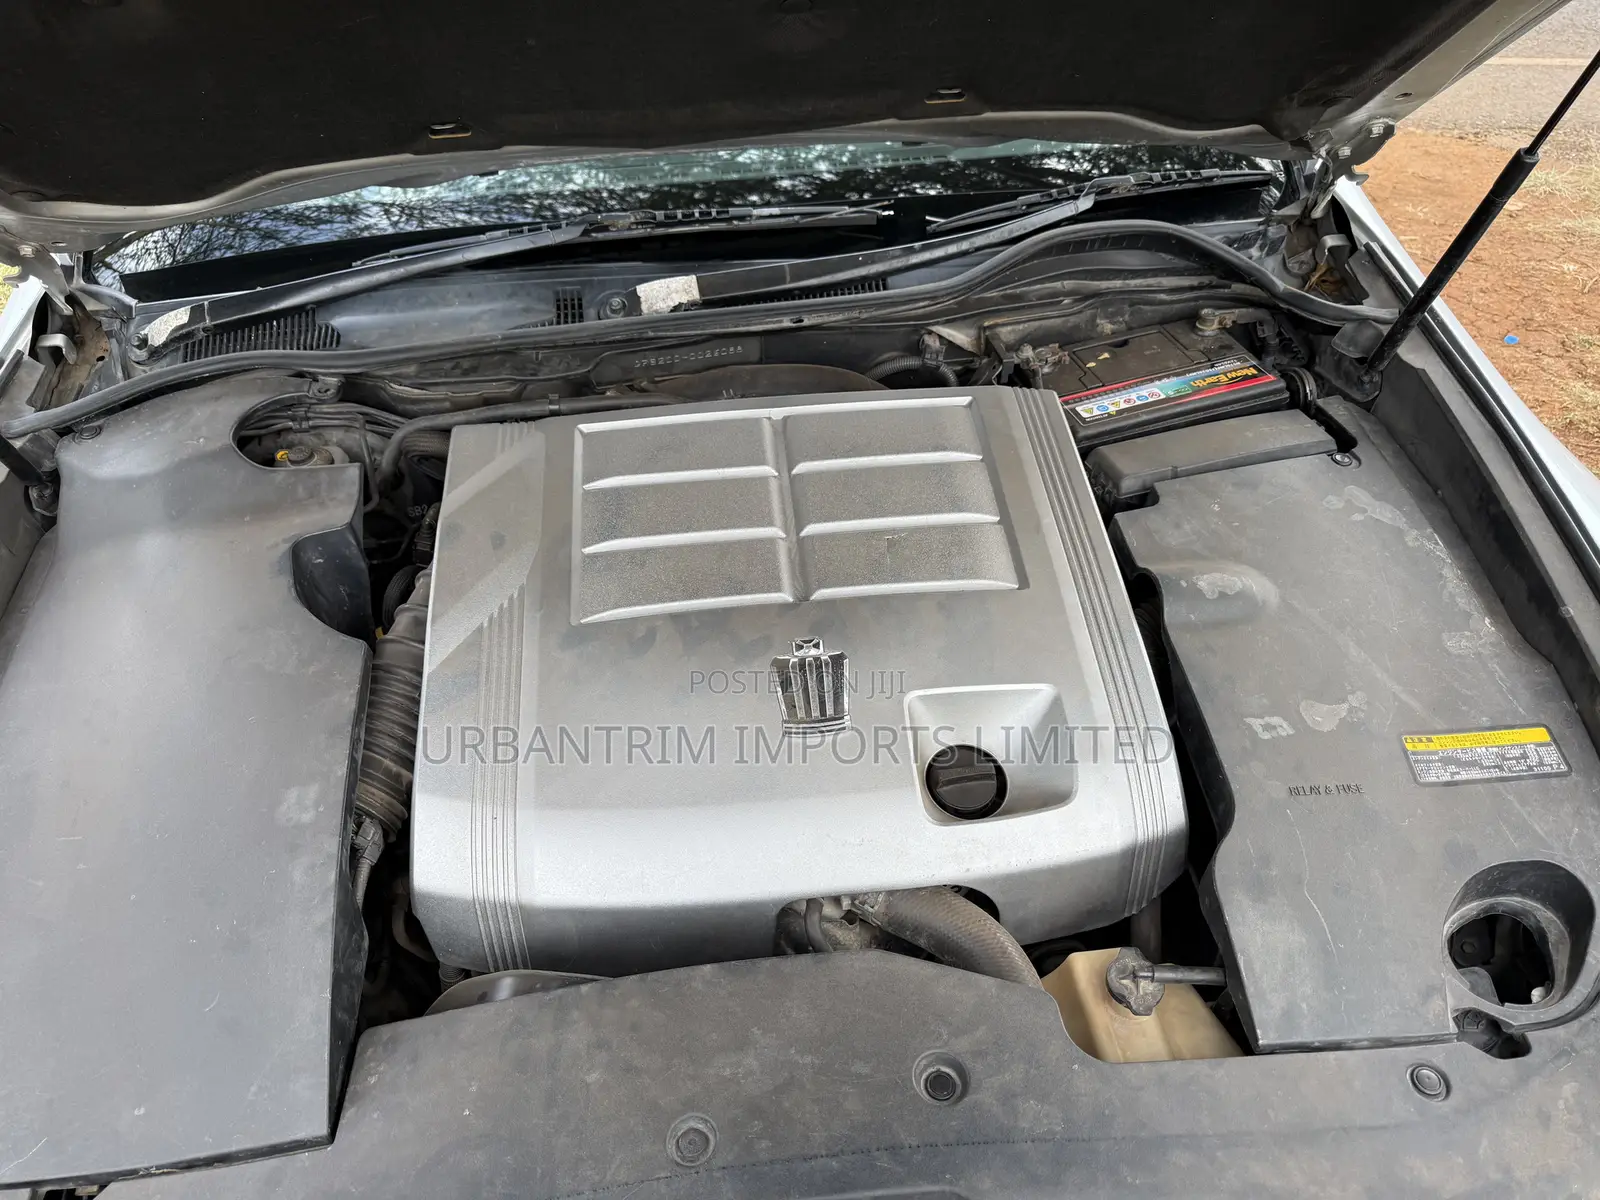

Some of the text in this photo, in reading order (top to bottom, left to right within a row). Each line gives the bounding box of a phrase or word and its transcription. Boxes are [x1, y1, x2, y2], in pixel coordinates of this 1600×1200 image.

[1226, 366, 1258, 380] New
[1190, 373, 1229, 388] Earth
[1288, 783, 1365, 796] RELAY & FUSE
